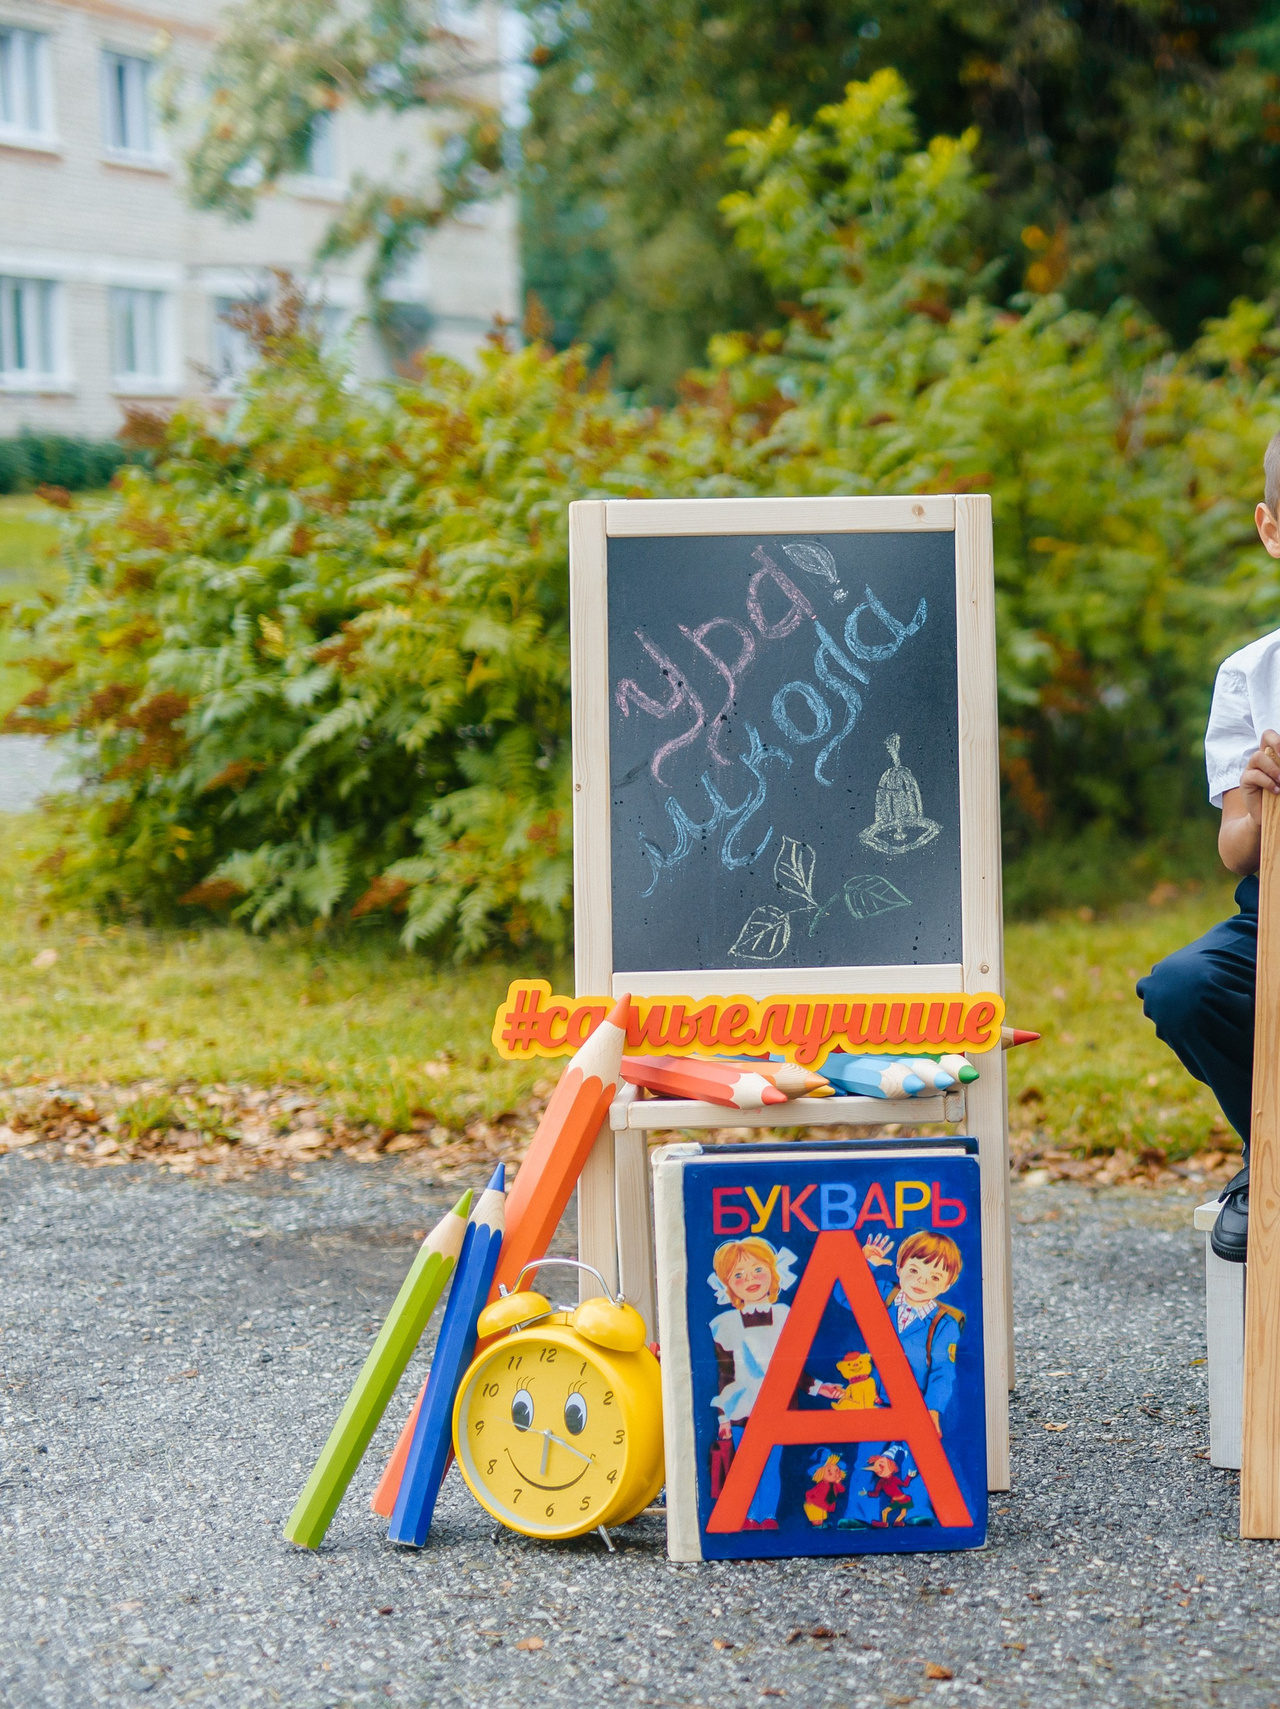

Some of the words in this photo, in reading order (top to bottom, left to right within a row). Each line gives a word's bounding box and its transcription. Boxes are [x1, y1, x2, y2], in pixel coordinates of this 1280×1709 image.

[711, 1180, 968, 1235] БУКВАРЬ
[507, 1356, 523, 1370] 11
[539, 1348, 557, 1363] 12
[580, 1361, 588, 1376] 1
[482, 1383, 500, 1398] 10
[603, 1391, 614, 1406] 2
[475, 1420, 485, 1436] 9
[613, 1429, 626, 1445] 3
[486, 1459, 497, 1475] 8
[606, 1469, 618, 1485] 4
[512, 1489, 523, 1504] 7
[579, 1496, 591, 1511] 5
[545, 1502, 555, 1518] 6
